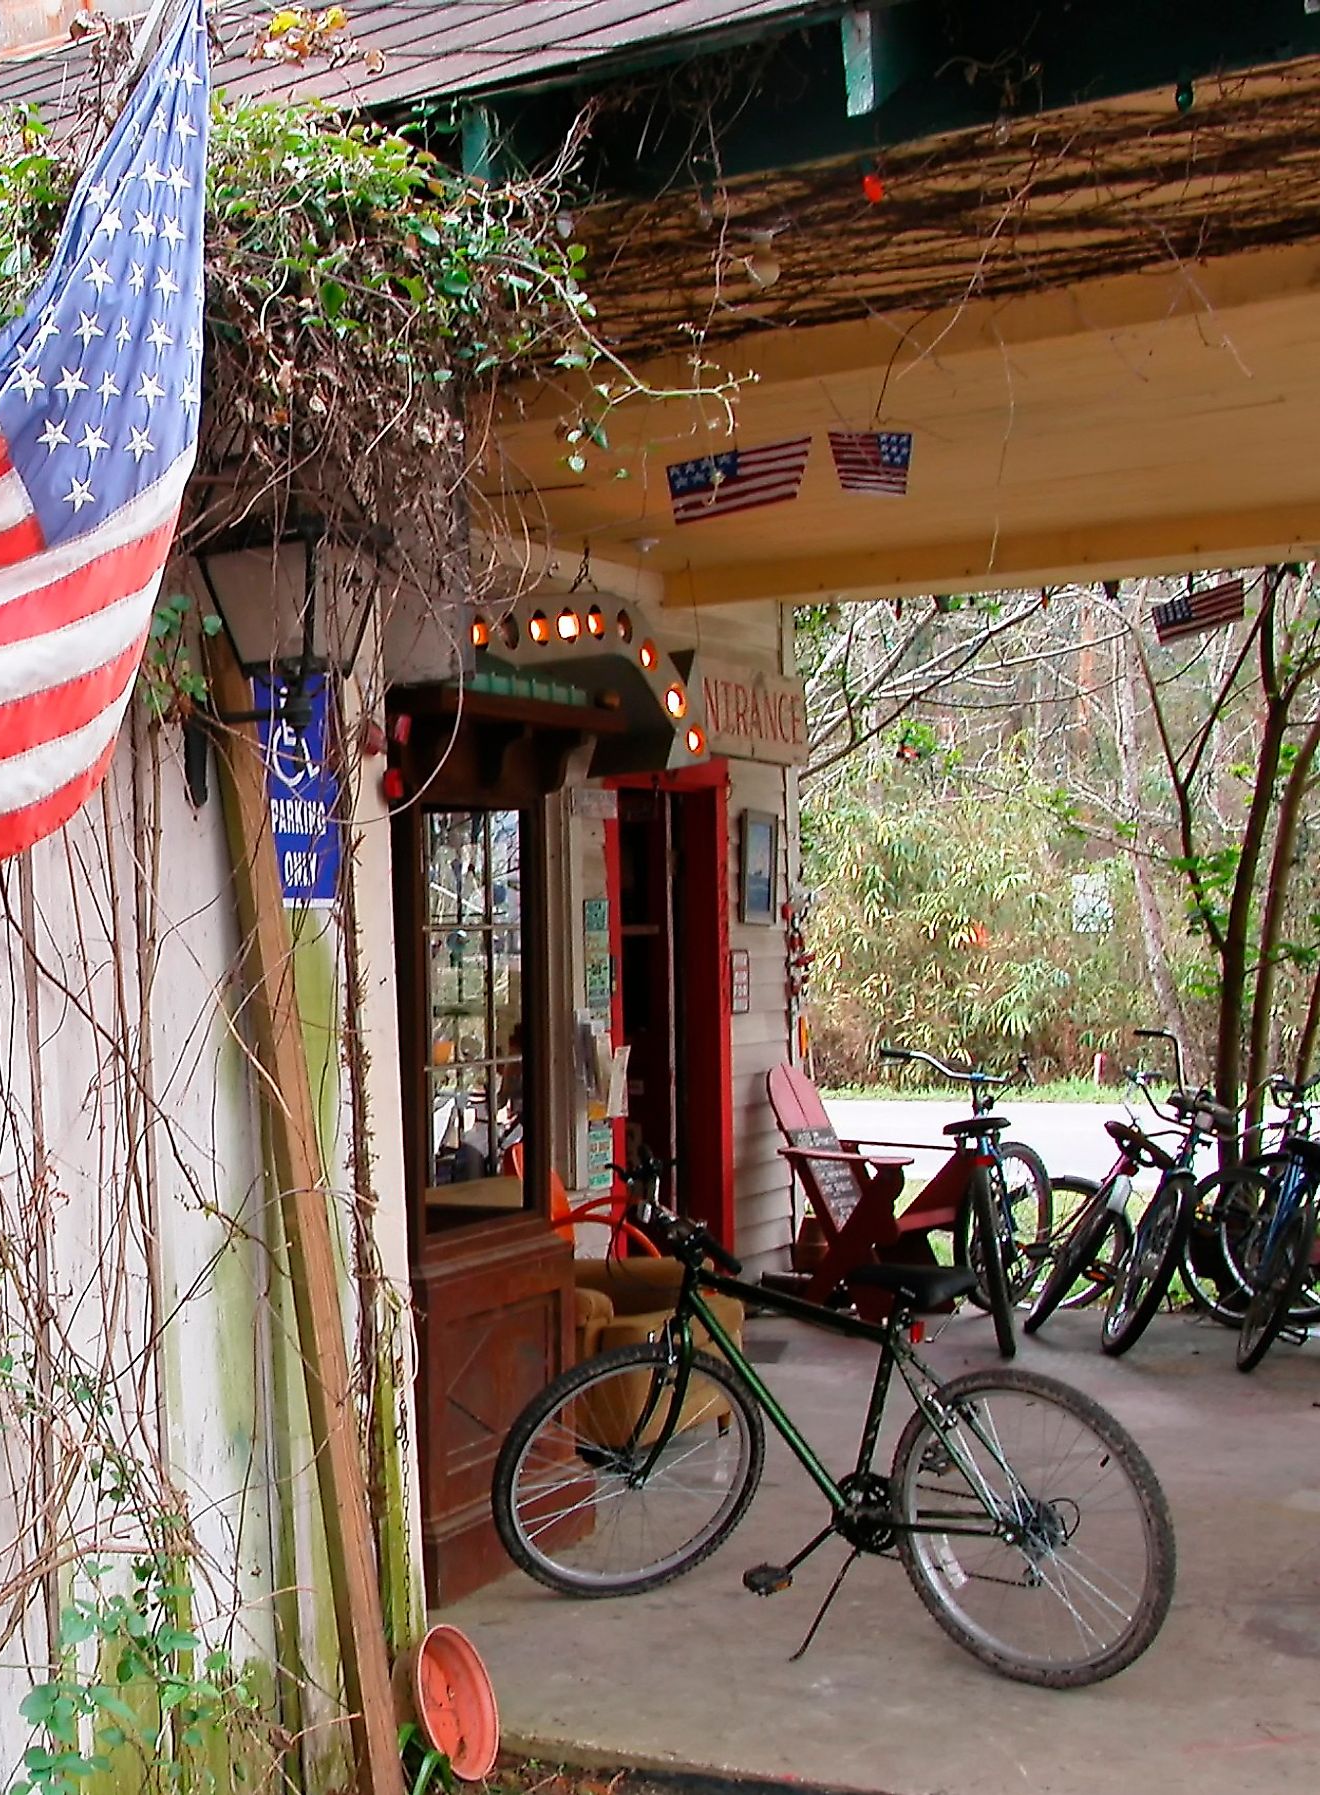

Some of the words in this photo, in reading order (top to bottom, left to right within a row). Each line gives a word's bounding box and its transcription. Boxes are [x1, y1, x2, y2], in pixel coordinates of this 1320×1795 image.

[702, 676, 803, 745] NTRANCE
[270, 798, 328, 836] PARKING
[283, 850, 318, 888] ONLY
